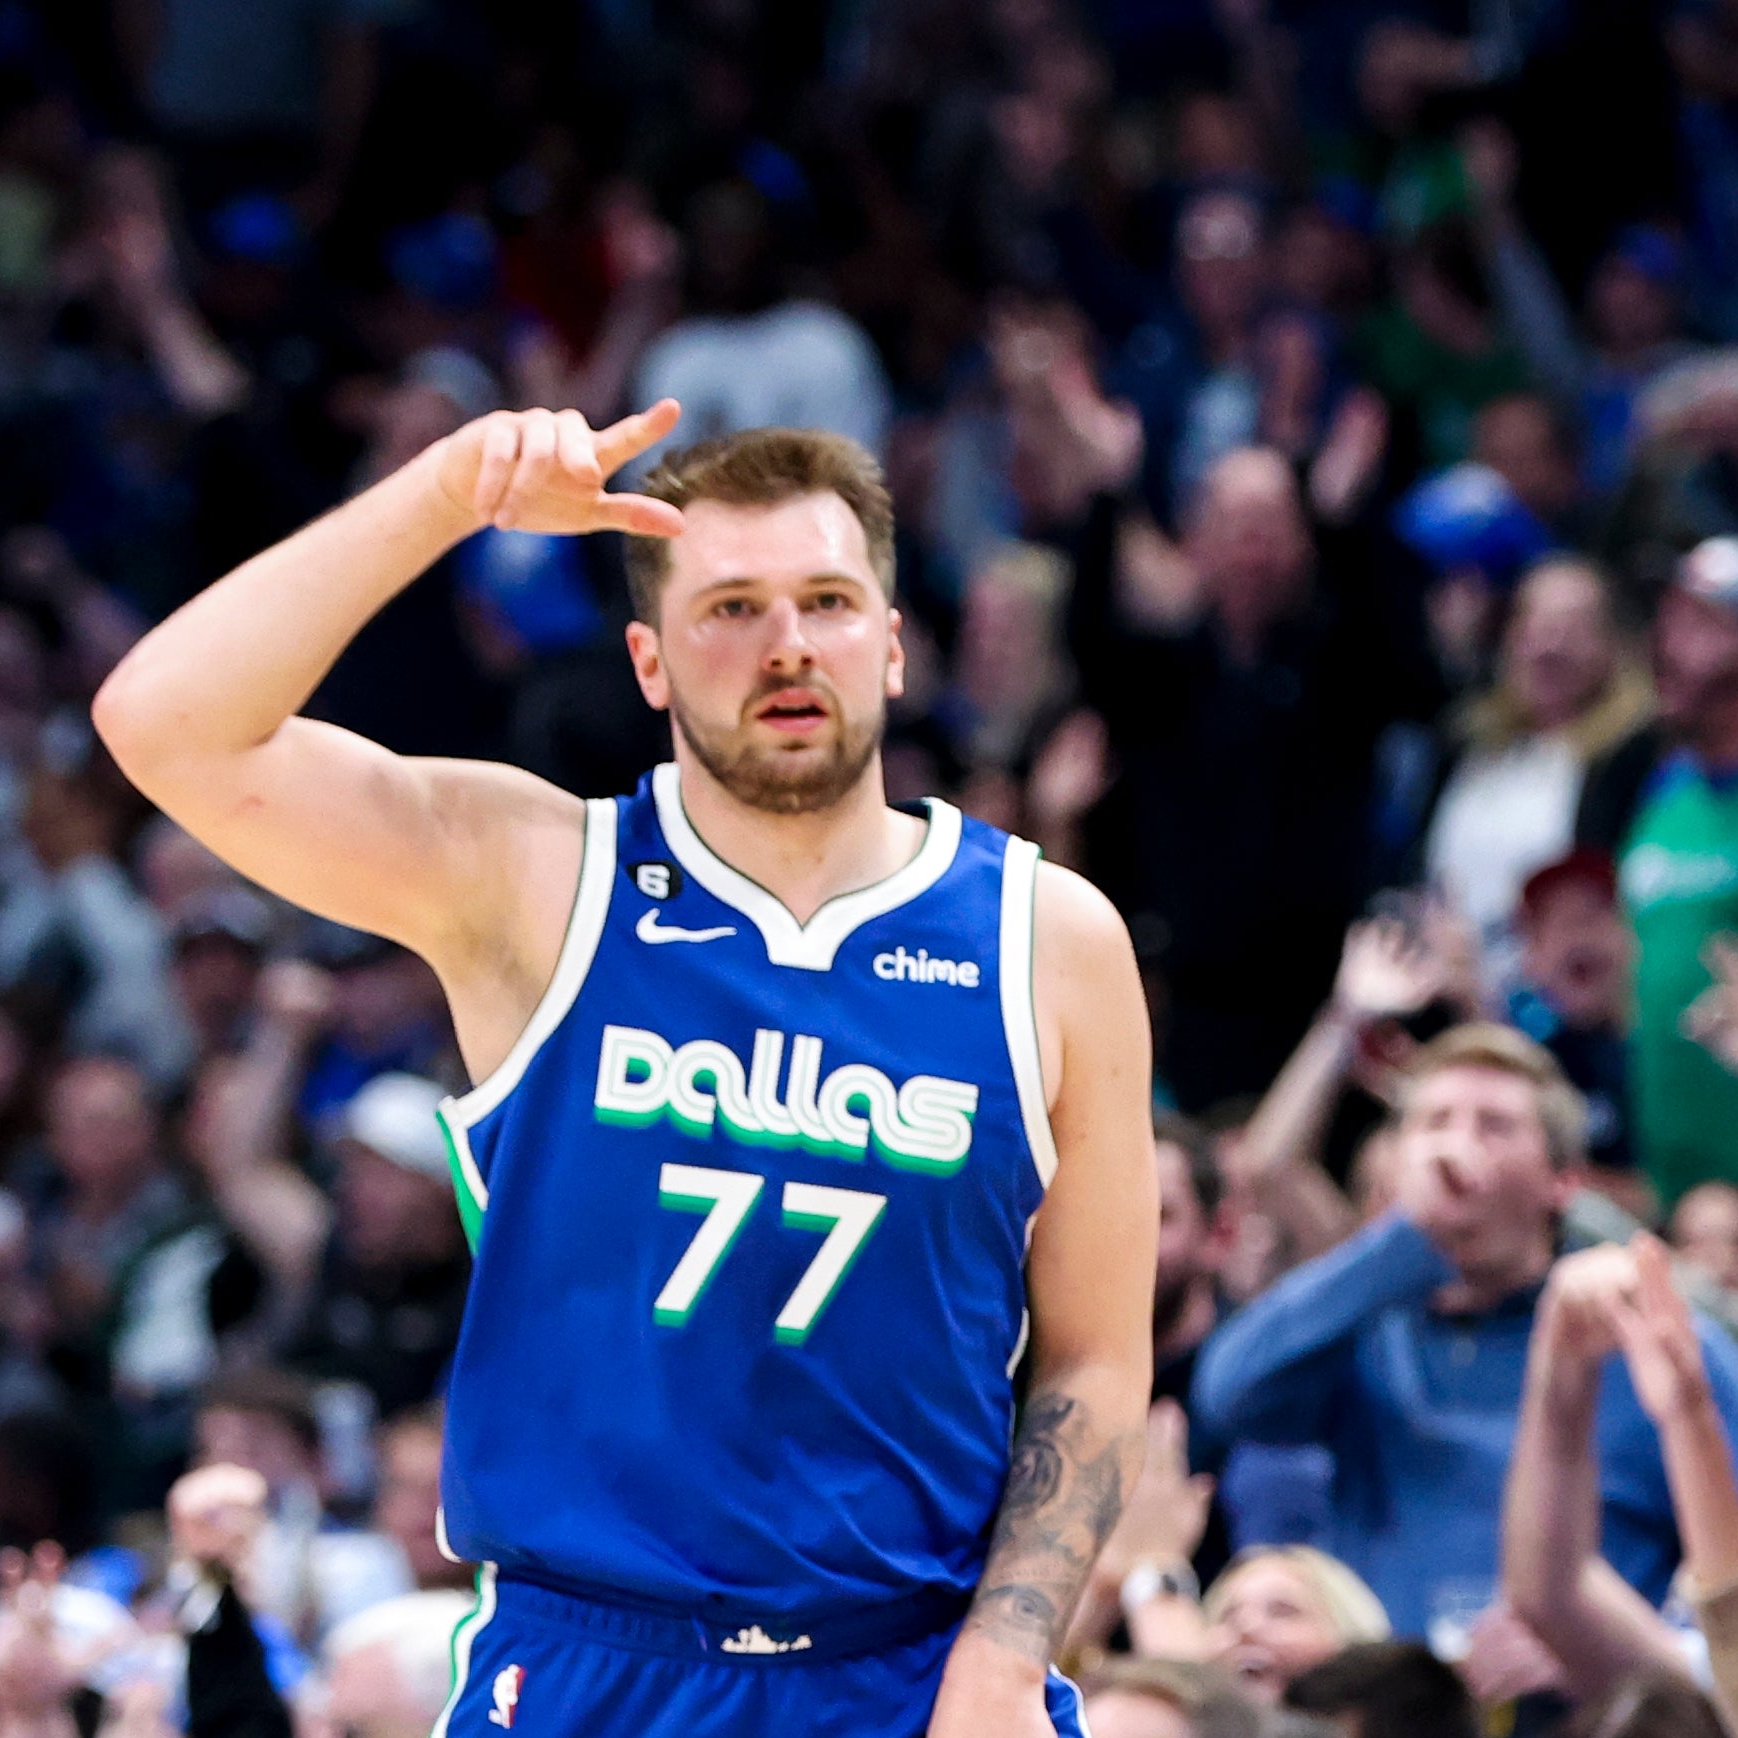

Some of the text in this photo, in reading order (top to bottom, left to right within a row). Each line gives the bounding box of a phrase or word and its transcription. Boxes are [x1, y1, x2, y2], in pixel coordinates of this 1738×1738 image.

[637, 864, 670, 899] 6
[873, 945, 980, 988] chime
[594, 1024, 978, 1176] Dallas
[653, 1163, 887, 1346] 77
